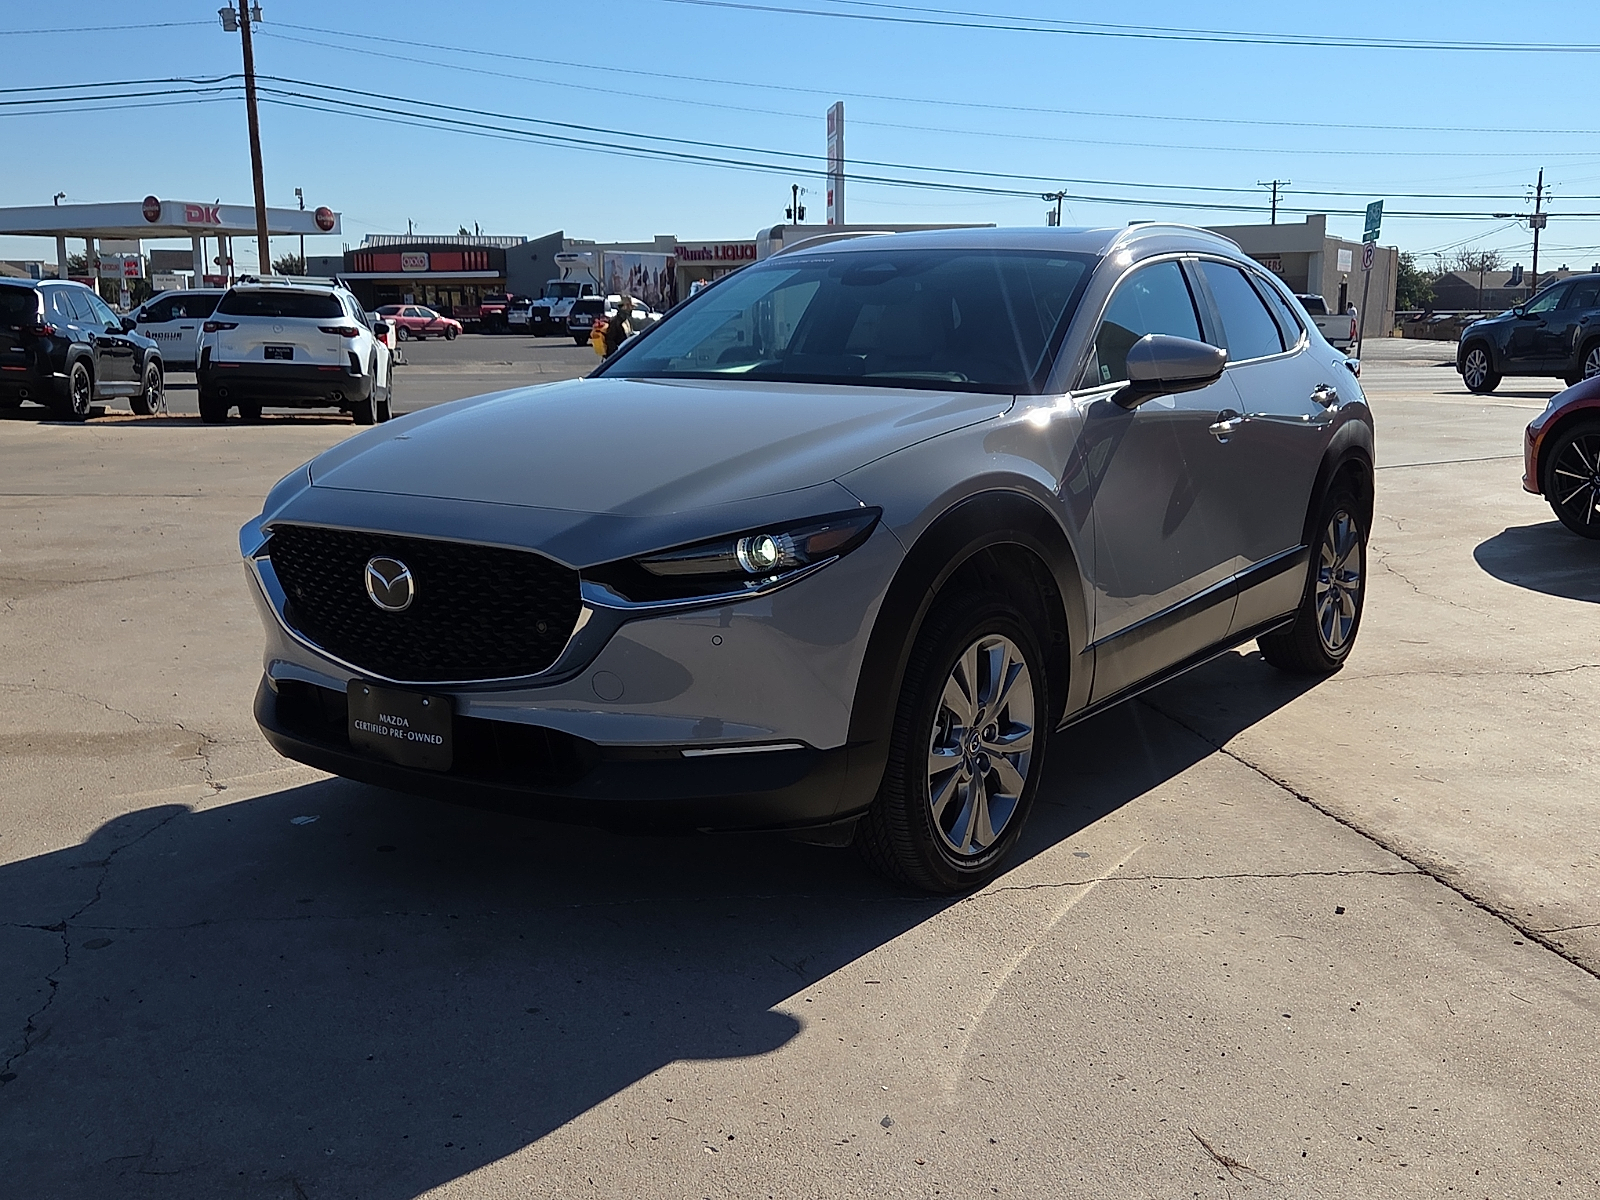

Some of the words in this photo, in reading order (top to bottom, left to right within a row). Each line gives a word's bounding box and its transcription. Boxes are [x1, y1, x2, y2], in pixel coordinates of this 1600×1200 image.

[185, 203, 222, 225] DK
[403, 257, 425, 267] OXXO
[379, 713, 409, 728] MAZDA
[354, 719, 388, 736] CERTIFIED
[389, 727, 443, 745] PRE-OWNED
